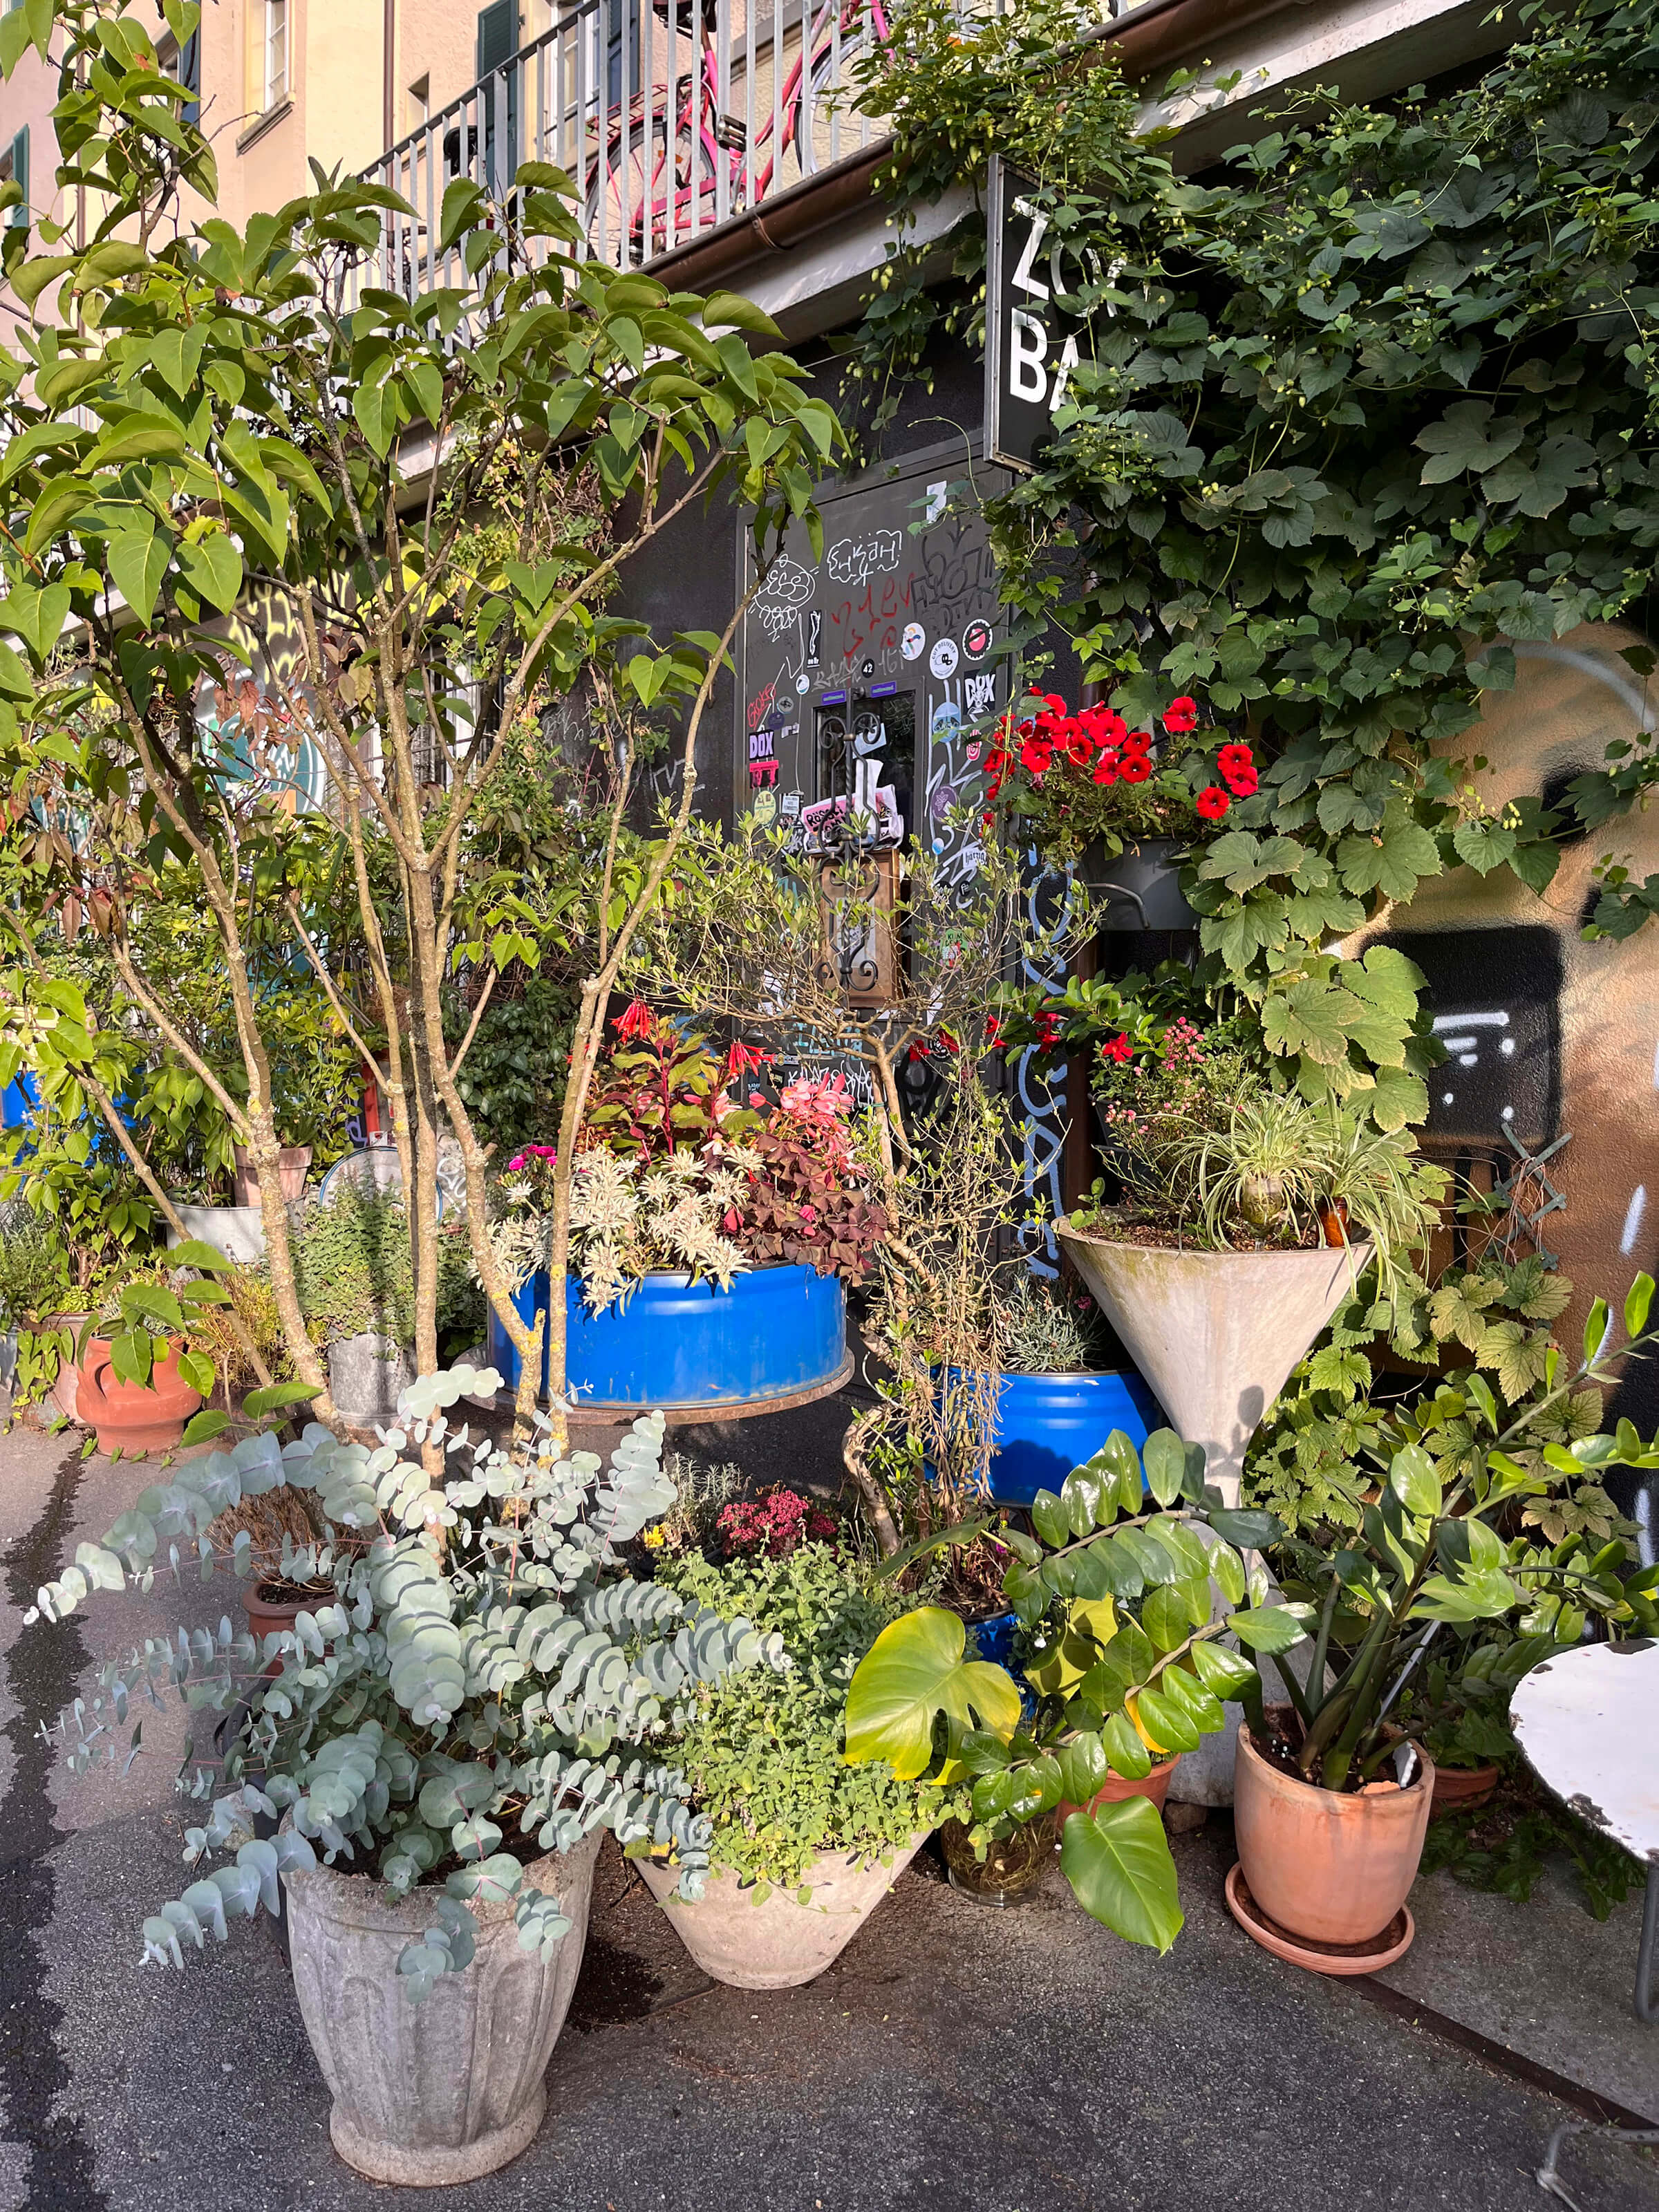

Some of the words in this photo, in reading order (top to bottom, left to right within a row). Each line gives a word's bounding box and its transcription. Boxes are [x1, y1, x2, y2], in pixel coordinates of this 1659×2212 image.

[862, 662, 873, 673] 42
[964, 673, 996, 709] DOX
[749, 731, 774, 759] DOX
